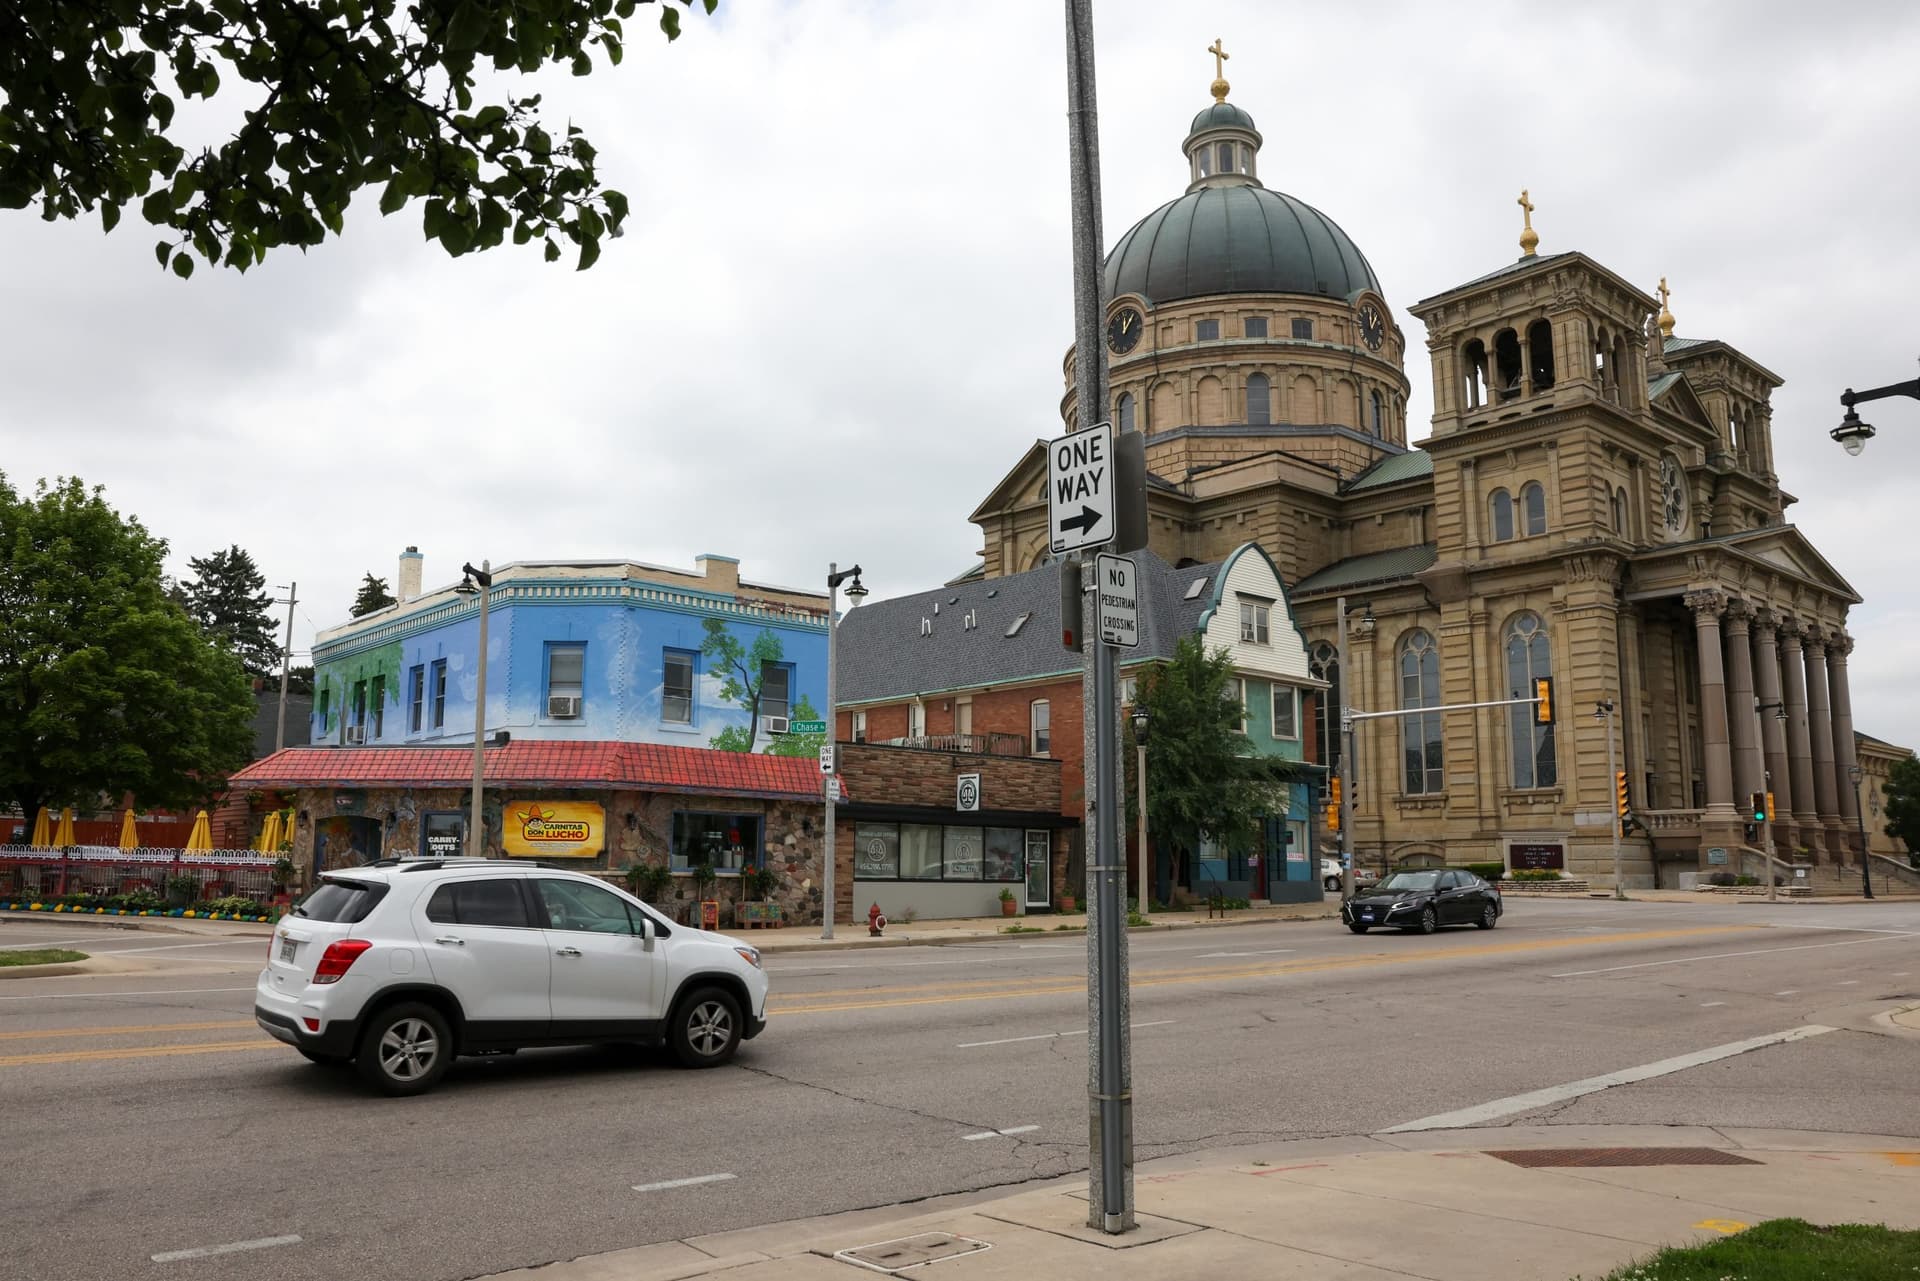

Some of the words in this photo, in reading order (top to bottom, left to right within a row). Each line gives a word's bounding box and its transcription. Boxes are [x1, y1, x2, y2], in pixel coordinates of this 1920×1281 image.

[1058, 434, 1103, 472] ONE
[1057, 467, 1104, 505] WAY
[1110, 568, 1125, 587] NO
[1101, 593, 1136, 610] PEDESTRIAN
[1103, 615, 1135, 632] CROSSING
[797, 723, 818, 731] Chase
[822, 747, 832, 755] ONE
[546, 830, 584, 839] LUCHO
